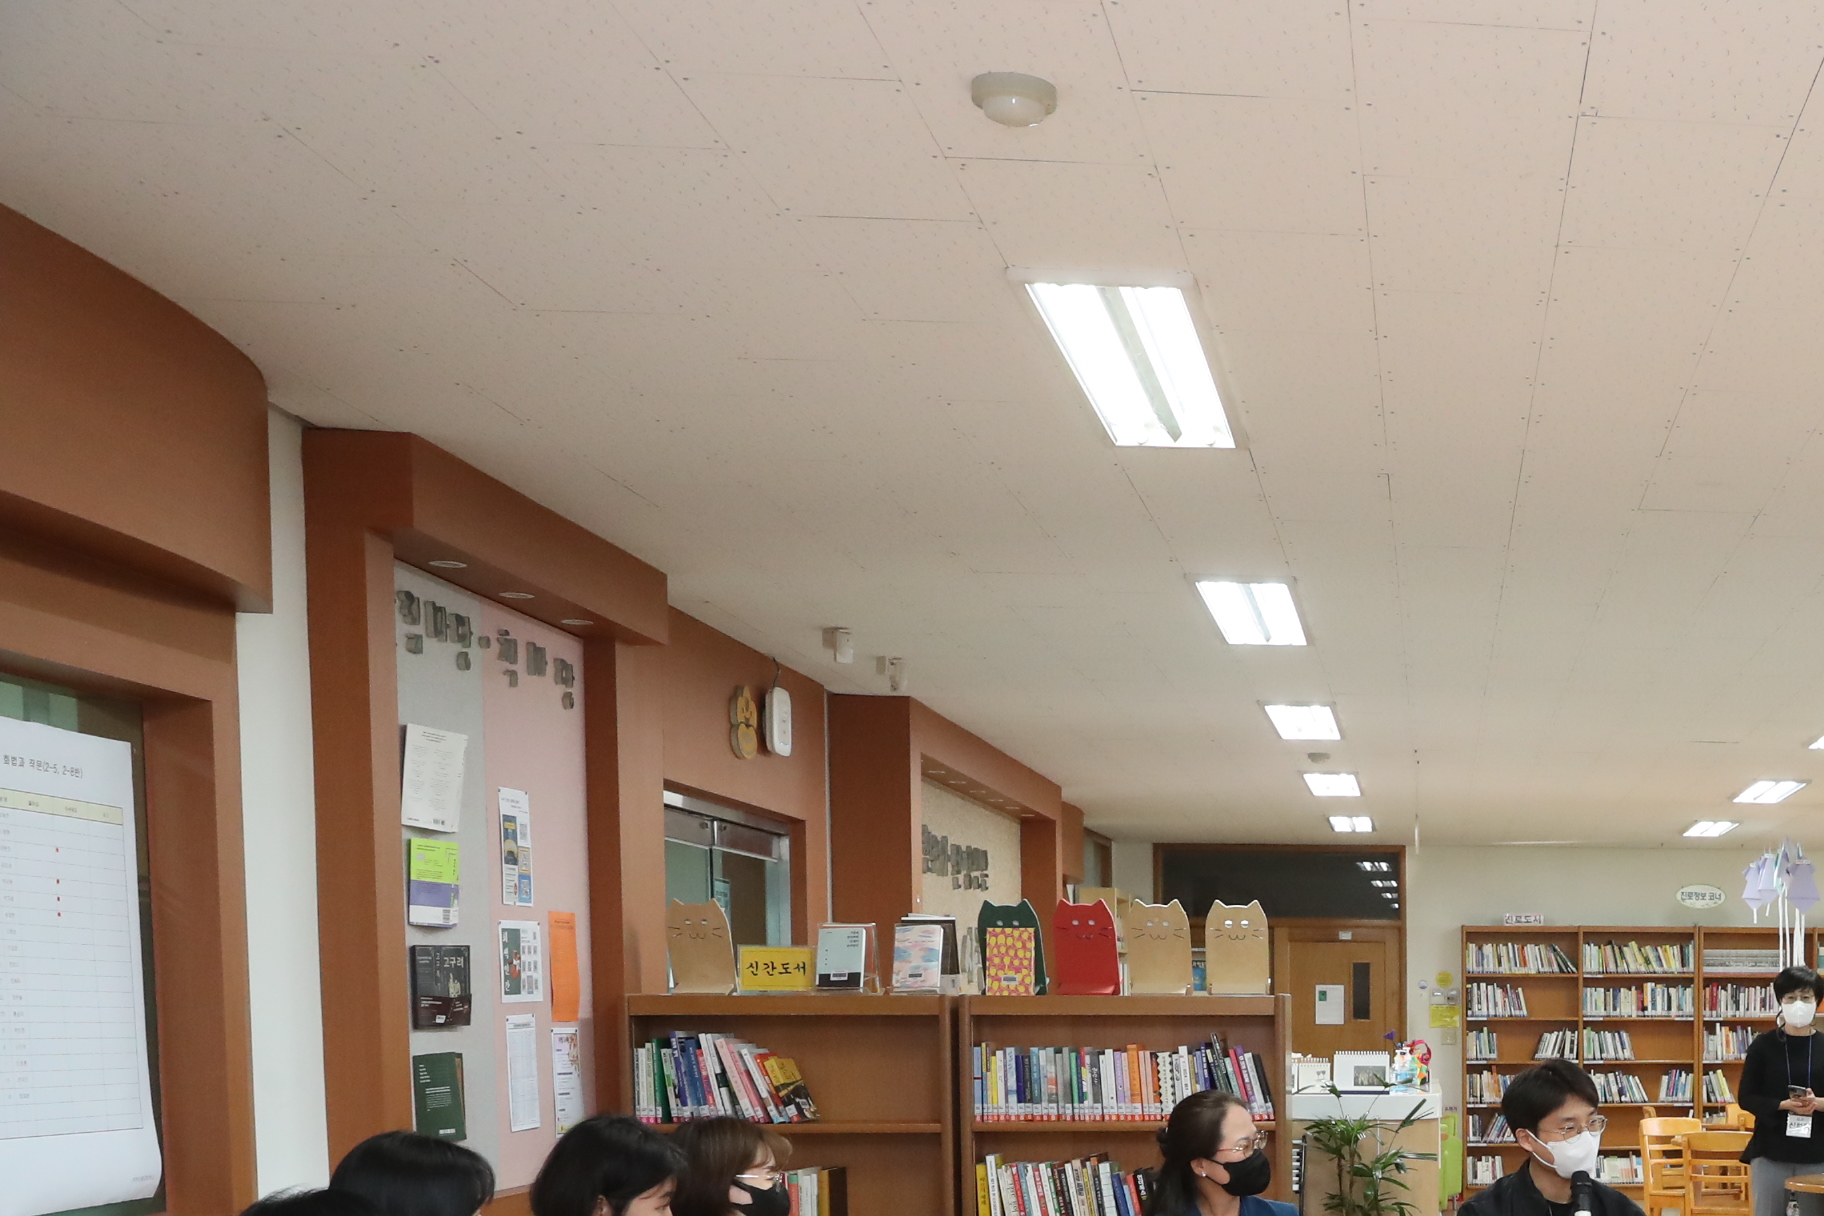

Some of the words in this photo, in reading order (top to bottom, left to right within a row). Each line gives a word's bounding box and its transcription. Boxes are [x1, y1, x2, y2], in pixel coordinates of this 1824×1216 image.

[1680, 891, 1707, 901] 진로정보
[1708, 892, 1722, 901] 코너
[1504, 914, 1542, 924] 진로도서
[443, 956, 464, 968] 고구려
[746, 960, 807, 977] 신간도서
